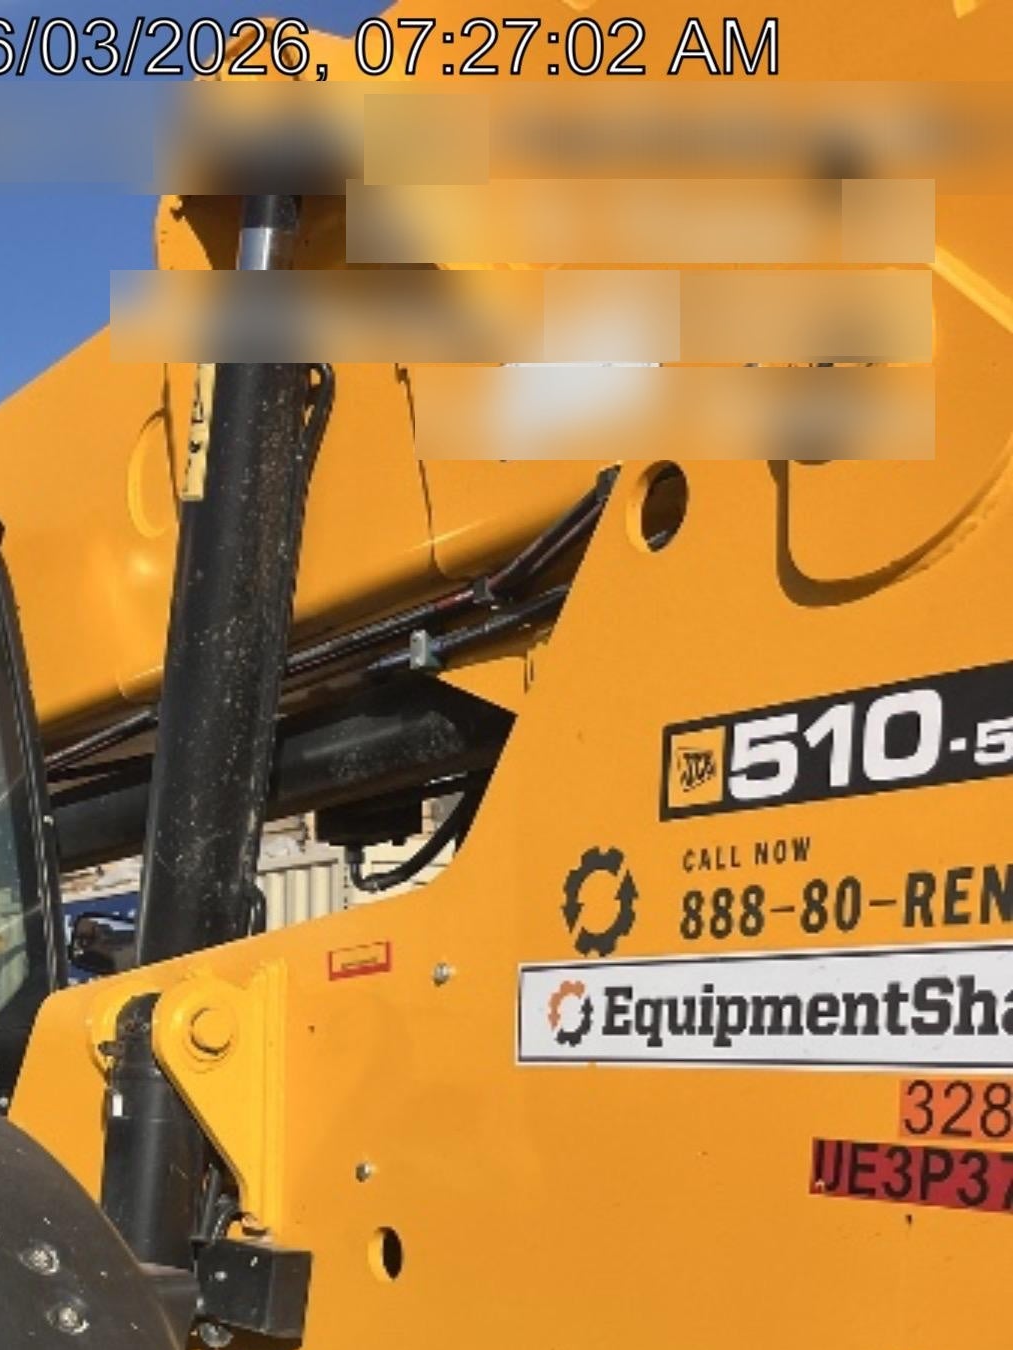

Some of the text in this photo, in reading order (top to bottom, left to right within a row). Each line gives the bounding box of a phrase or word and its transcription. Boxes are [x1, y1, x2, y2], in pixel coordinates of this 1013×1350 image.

[682, 836, 811, 873] CALL NOW
[679, 863, 1013, 940] 888-80-REN
